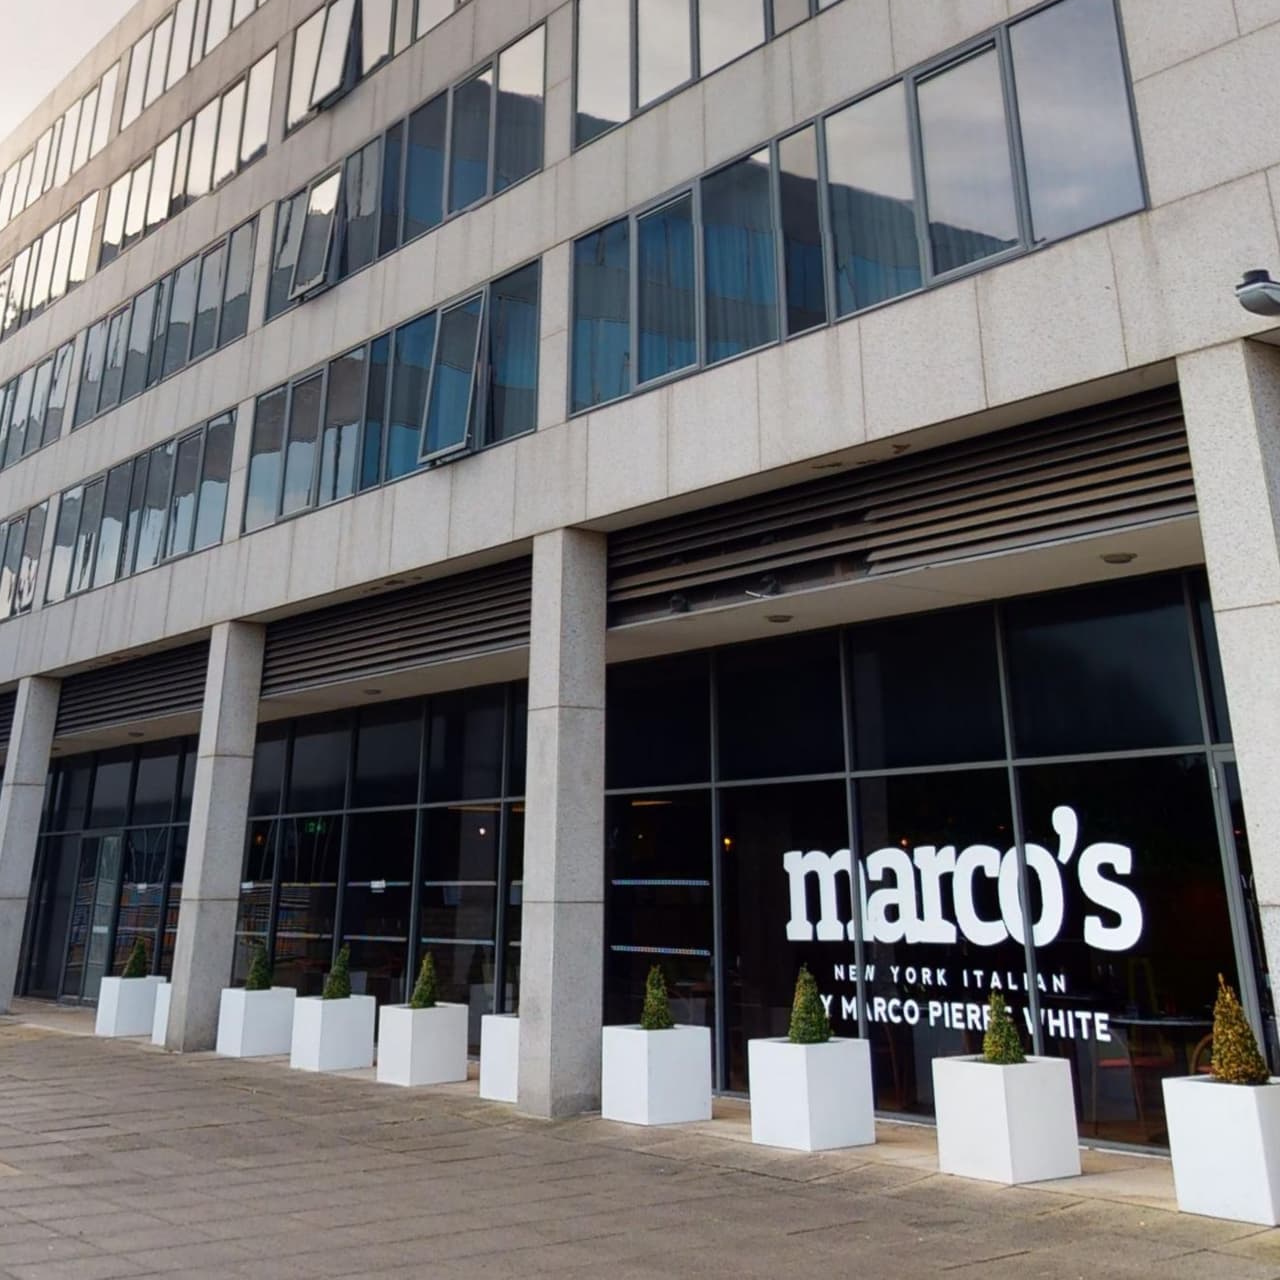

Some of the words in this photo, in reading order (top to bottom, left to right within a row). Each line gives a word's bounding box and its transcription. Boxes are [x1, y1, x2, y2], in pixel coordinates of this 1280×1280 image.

[783, 805, 1144, 952] marco's
[834, 963, 876, 982] NEW
[890, 965, 947, 987] YORK
[962, 969, 1067, 993] ITALIAN
